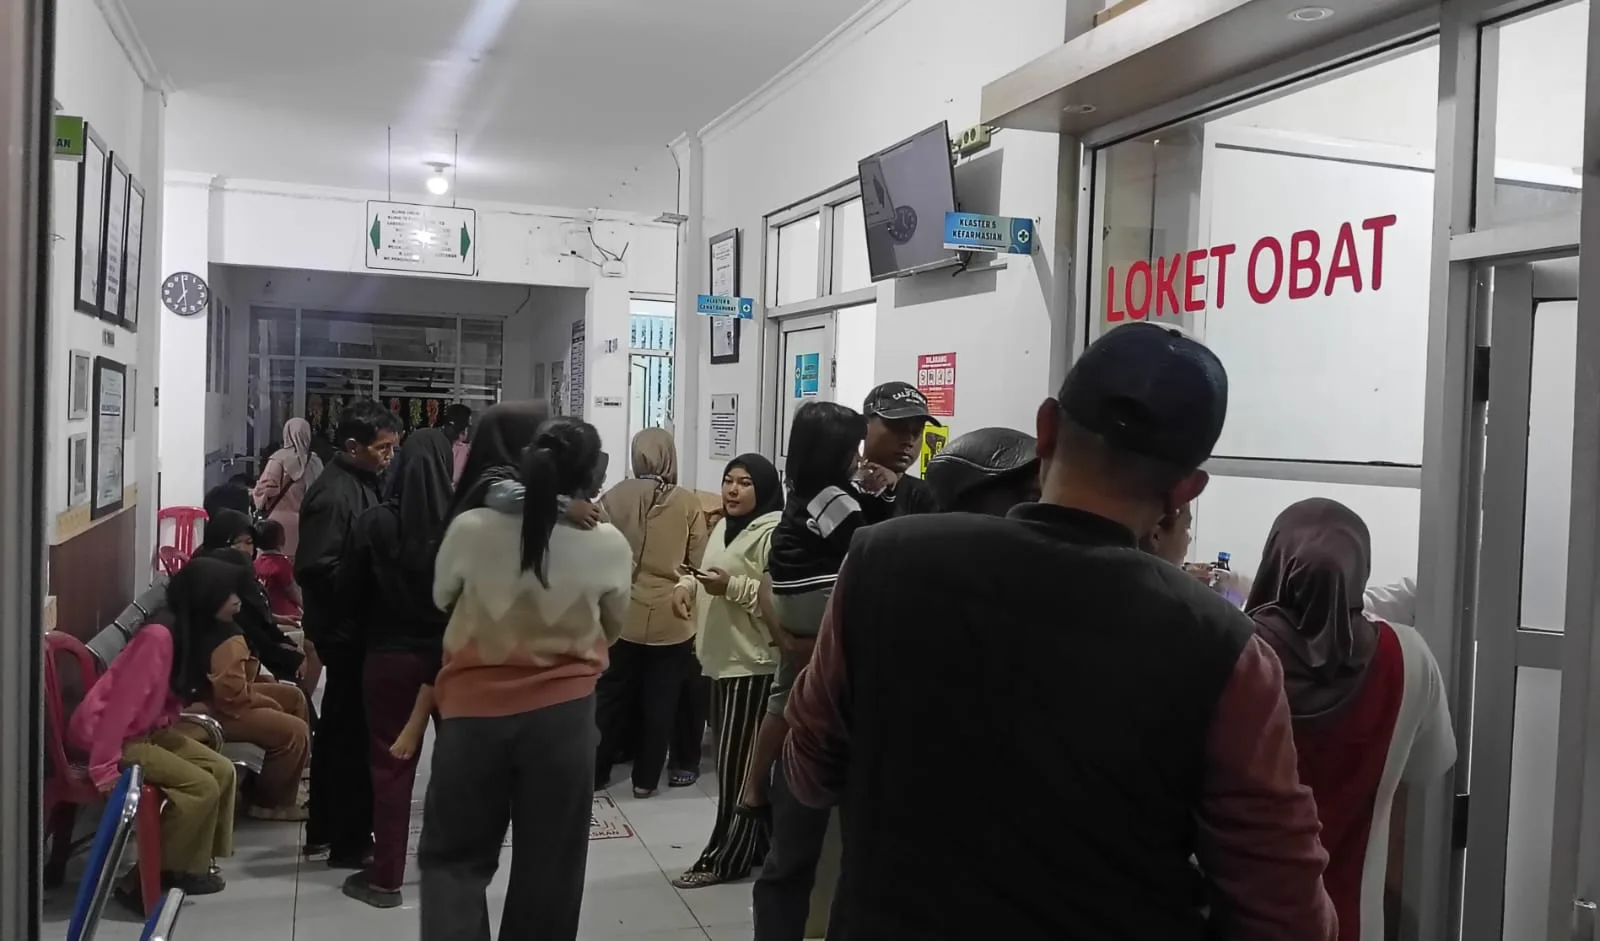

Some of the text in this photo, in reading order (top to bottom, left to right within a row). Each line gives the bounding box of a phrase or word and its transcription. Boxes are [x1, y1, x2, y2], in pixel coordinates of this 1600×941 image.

[960, 218, 990, 229] KLASTER
[952, 230, 1002, 240] KEFARMASIAN
[1106, 214, 1397, 322] LOKET OBAT
